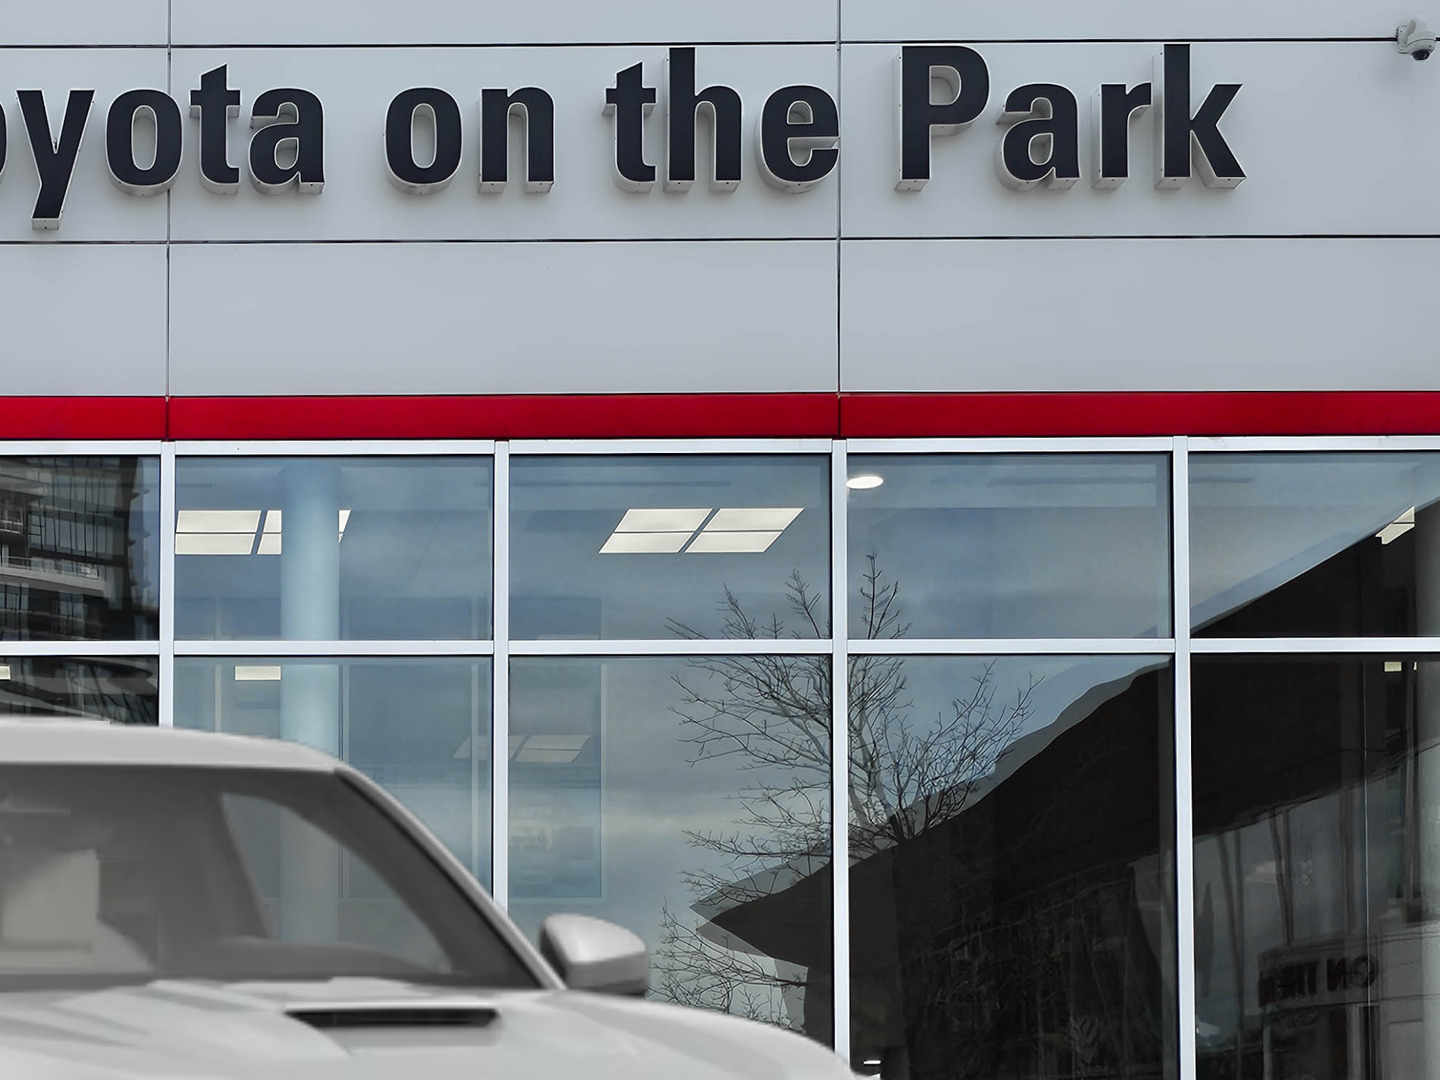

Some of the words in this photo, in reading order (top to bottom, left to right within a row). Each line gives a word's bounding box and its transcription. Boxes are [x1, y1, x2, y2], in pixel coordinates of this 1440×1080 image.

[382, 86, 555, 195] on
[601, 46, 841, 194] the
[893, 43, 1248, 193] Park
